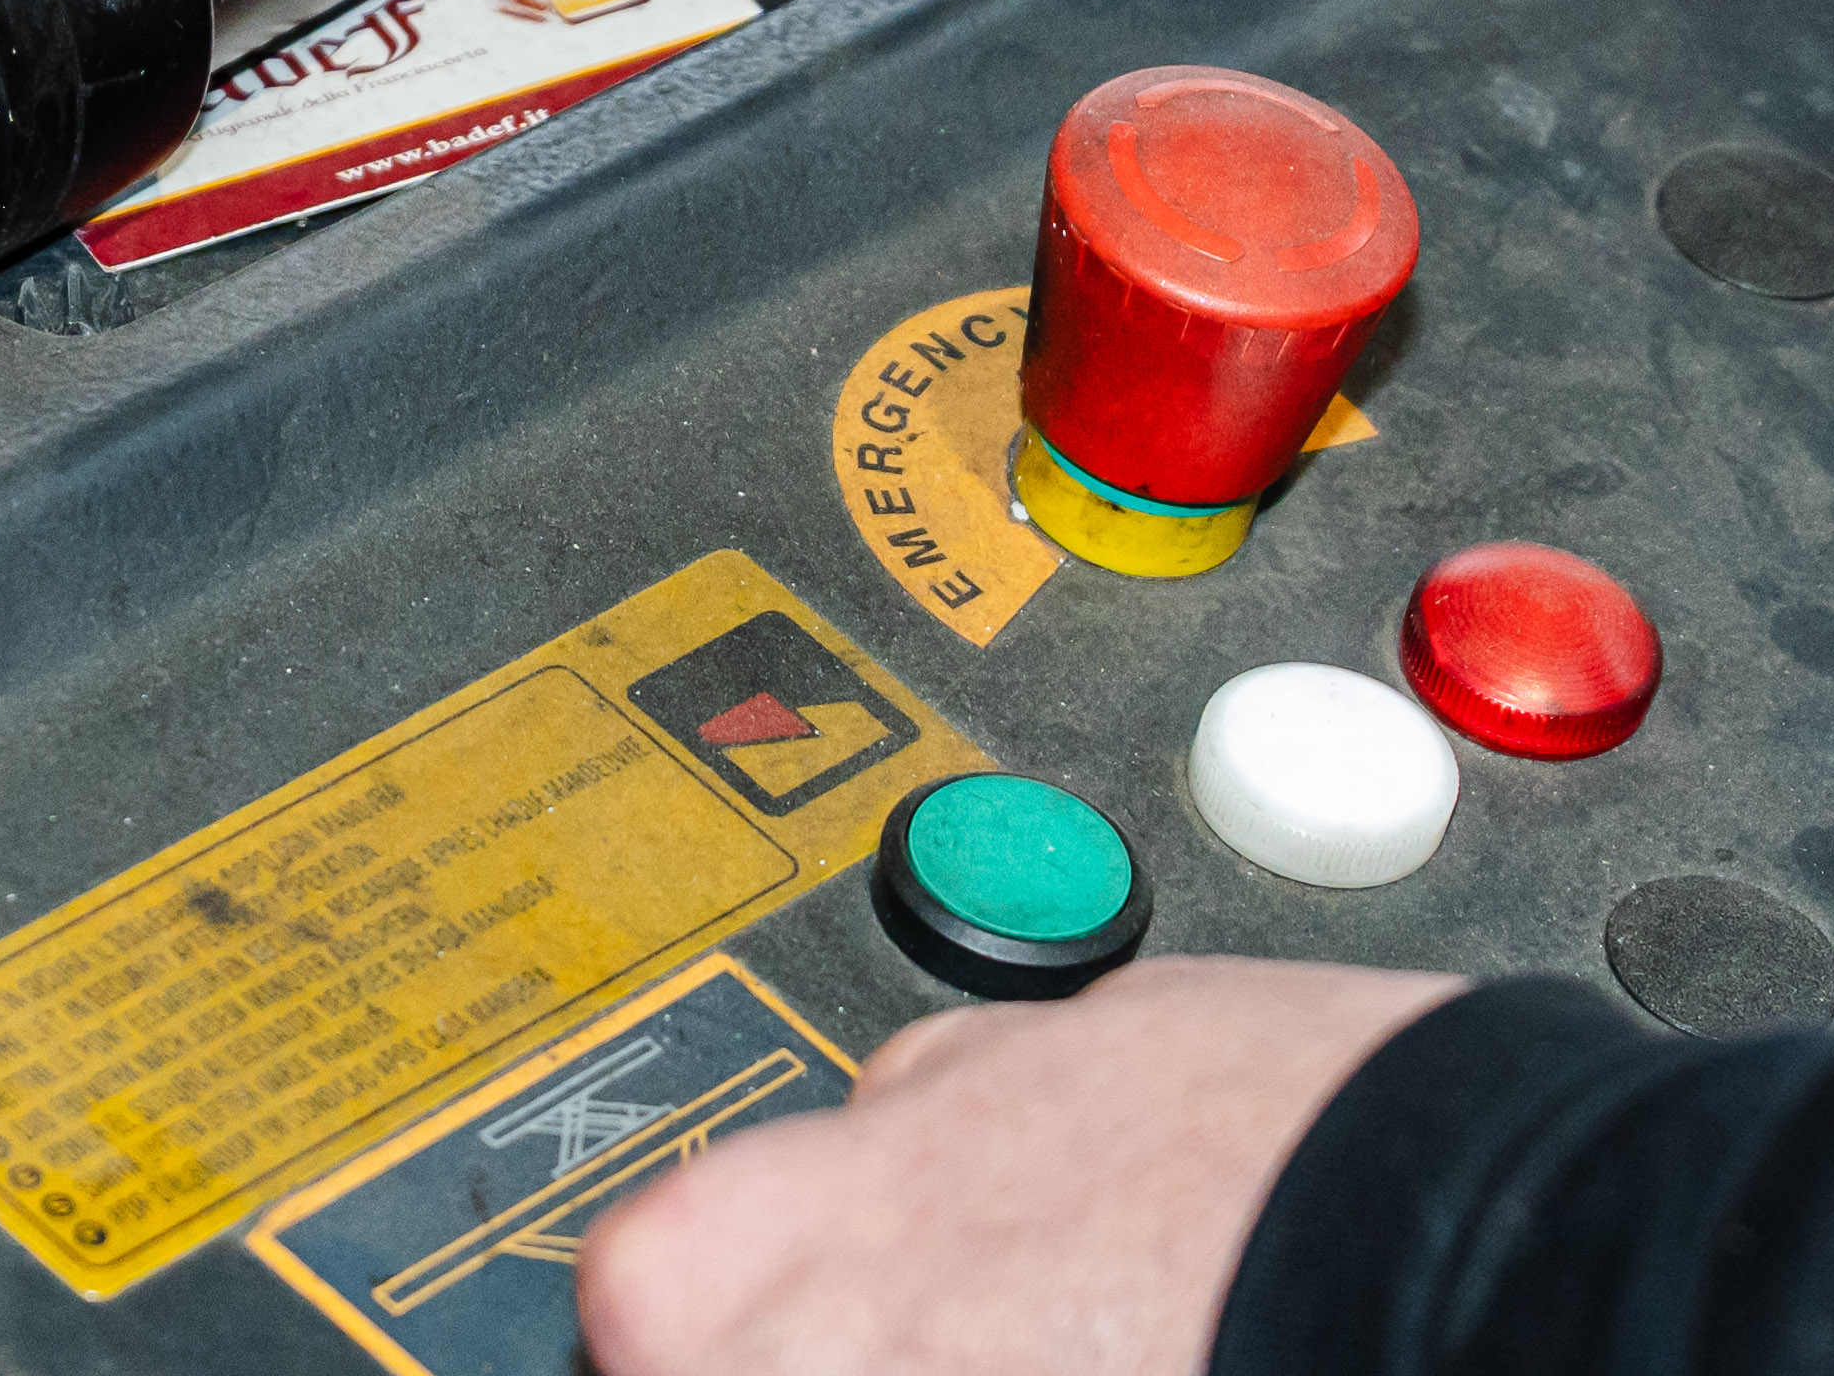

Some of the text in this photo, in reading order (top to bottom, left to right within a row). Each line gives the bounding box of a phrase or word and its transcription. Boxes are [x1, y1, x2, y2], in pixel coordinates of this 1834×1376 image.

[355, 46, 489, 93] Franciacorta
[334, 107, 551, 183] www.badef.it
[857, 306, 1028, 610] EMERGENC
